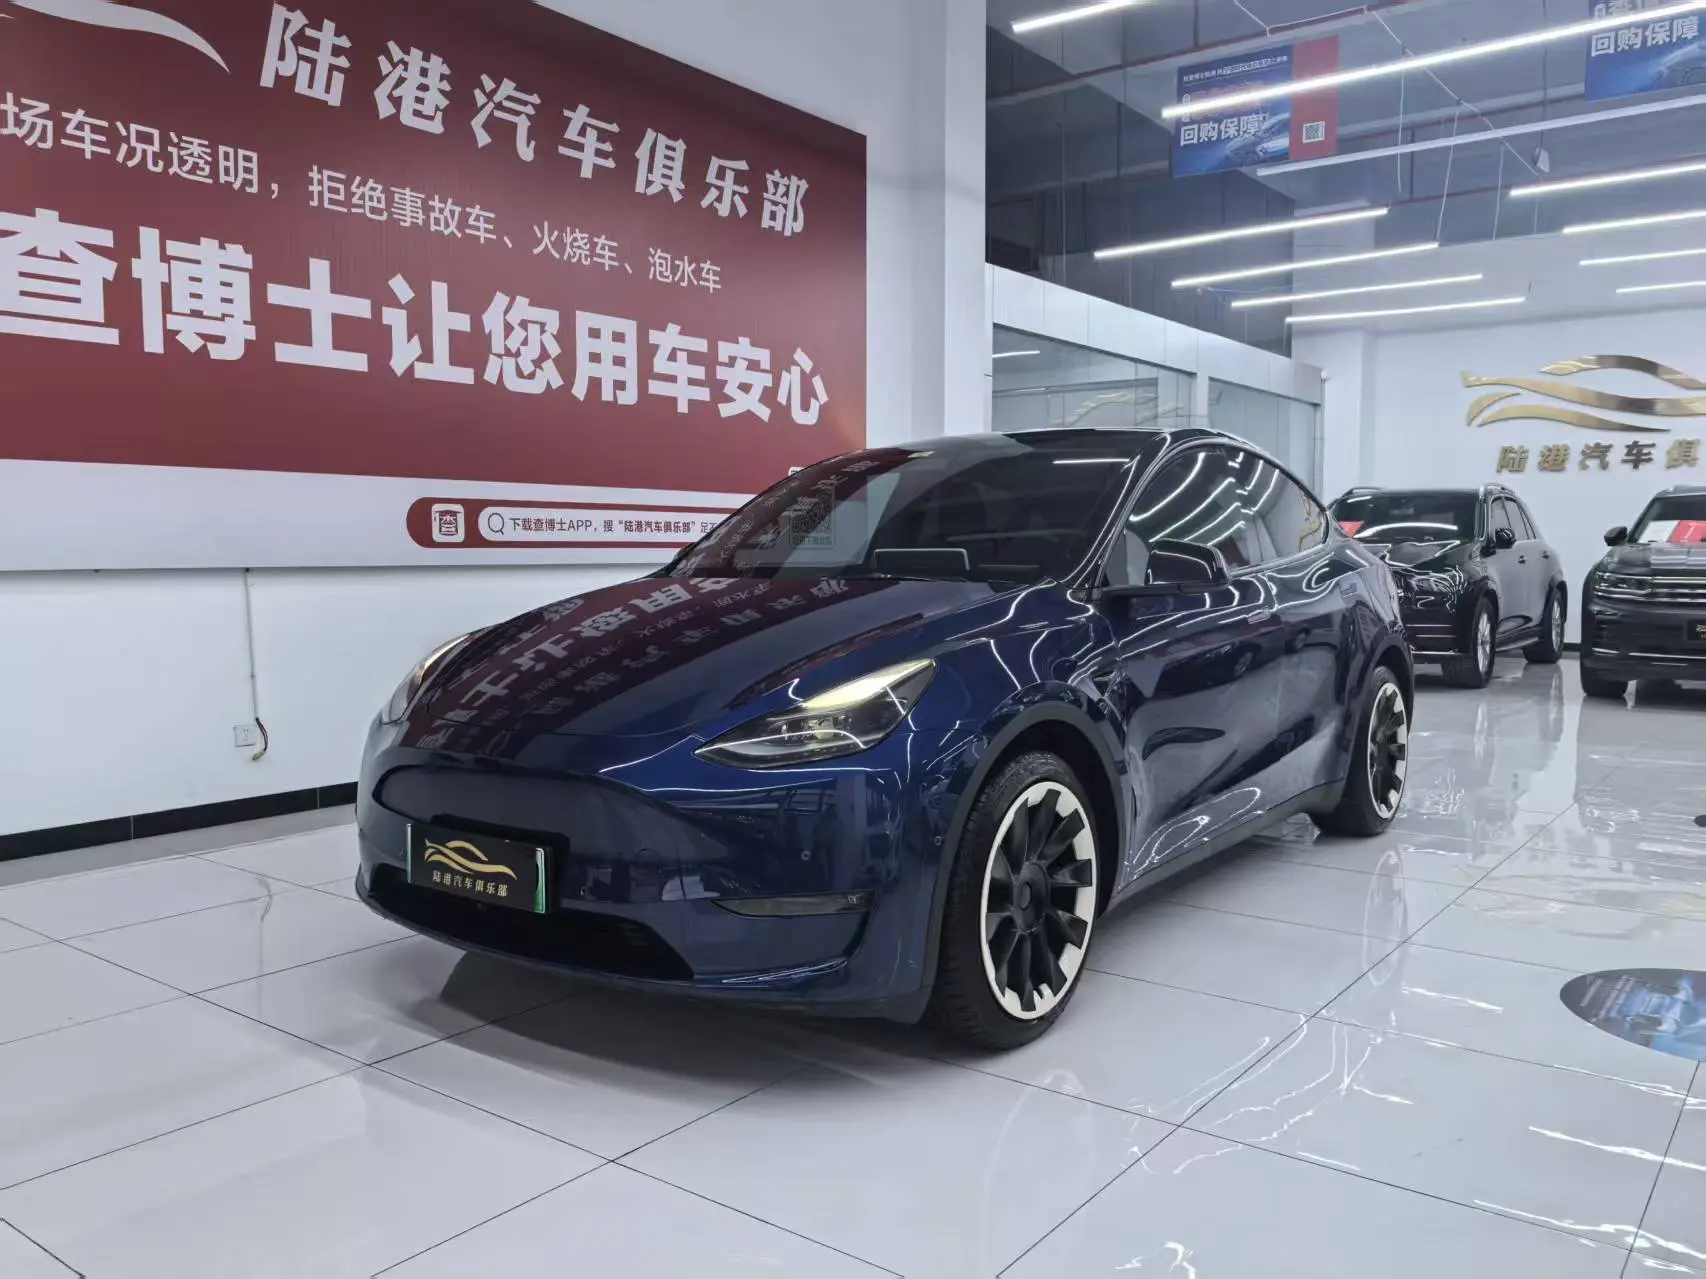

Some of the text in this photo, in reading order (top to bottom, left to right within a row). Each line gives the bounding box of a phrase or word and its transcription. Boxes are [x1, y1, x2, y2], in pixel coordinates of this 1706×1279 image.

[1591, 16, 1699, 56] 回购保障
[260, 2, 809, 236] 陆港汽车俱乐部
[1180, 114, 1260, 146] 回购保障
[0, 207, 829, 426] 查博士让您用车安心
[1496, 438, 1701, 473] 陆港汽车俱
[432, 869, 508, 897] 陆港汽车俱乐部
